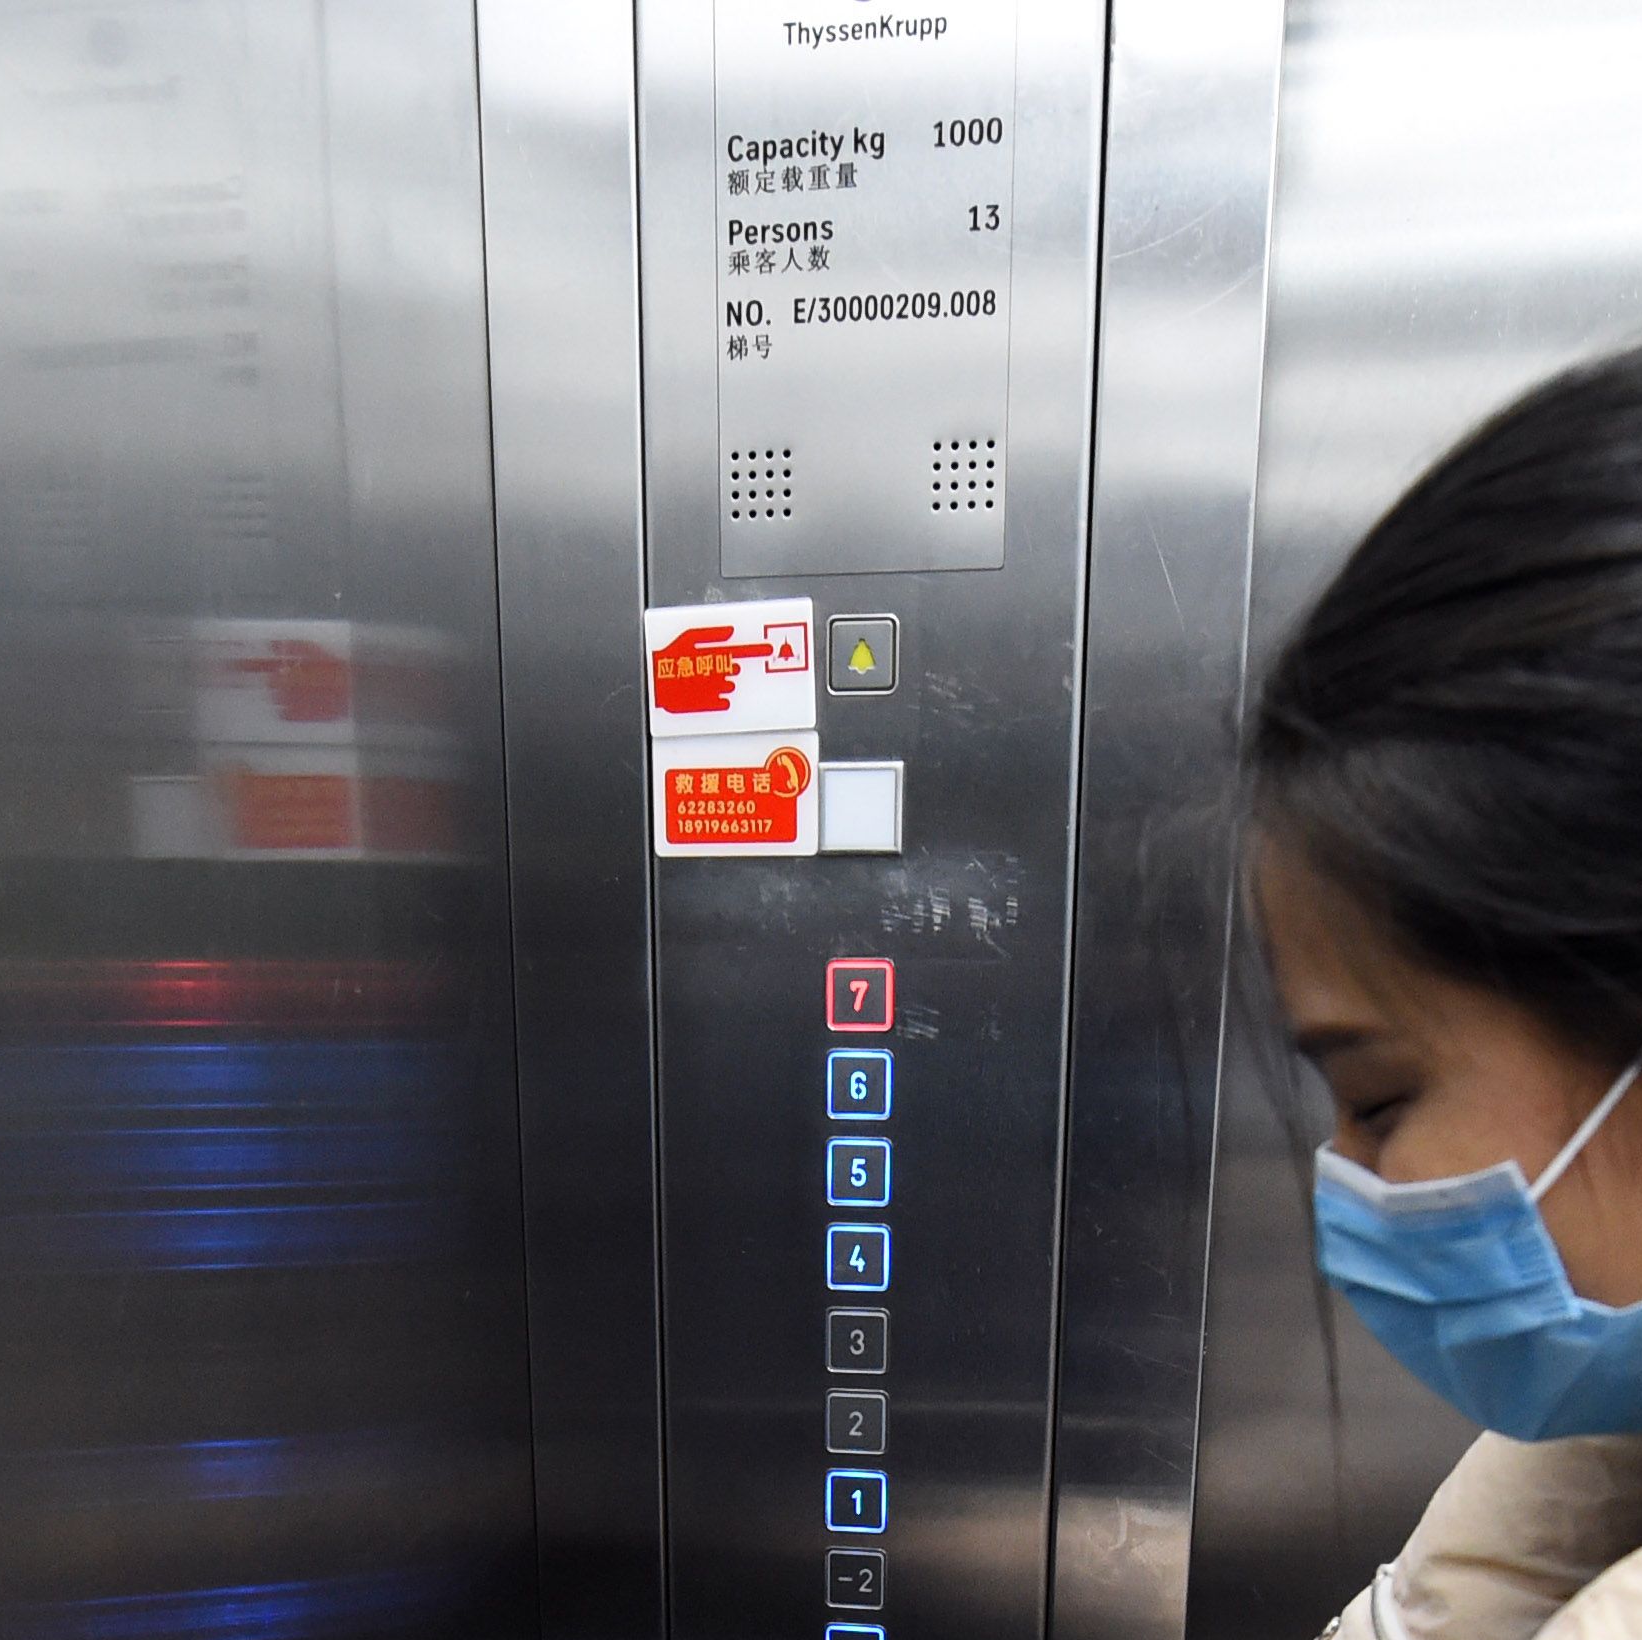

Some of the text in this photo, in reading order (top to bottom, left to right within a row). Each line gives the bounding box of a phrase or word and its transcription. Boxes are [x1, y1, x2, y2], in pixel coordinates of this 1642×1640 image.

[783, 15, 948, 49] ThyssenKrupp
[727, 117, 1004, 165] Capacity kg 1000
[727, 162, 858, 196] 额定载重量
[728, 204, 1000, 246] Persons 13
[727, 245, 830, 276] 乘客人数
[726, 289, 997, 327] NO. E/30000209.008
[726, 334, 773, 361] 梯号
[657, 653, 734, 679] 应急呼叫
[675, 772, 771, 794] 救援电话
[677, 800, 756, 815] 62283260
[678, 819, 773, 834] 18919663117
[849, 980, 869, 1012] 7
[849, 1070, 867, 1100] 6
[849, 1157, 867, 1188] 5
[849, 1244, 866, 1273] 4
[849, 1328, 865, 1356] 3
[848, 1410, 864, 1437] 2
[851, 1489, 862, 1516] 1
[837, 1568, 874, 1593] -2
